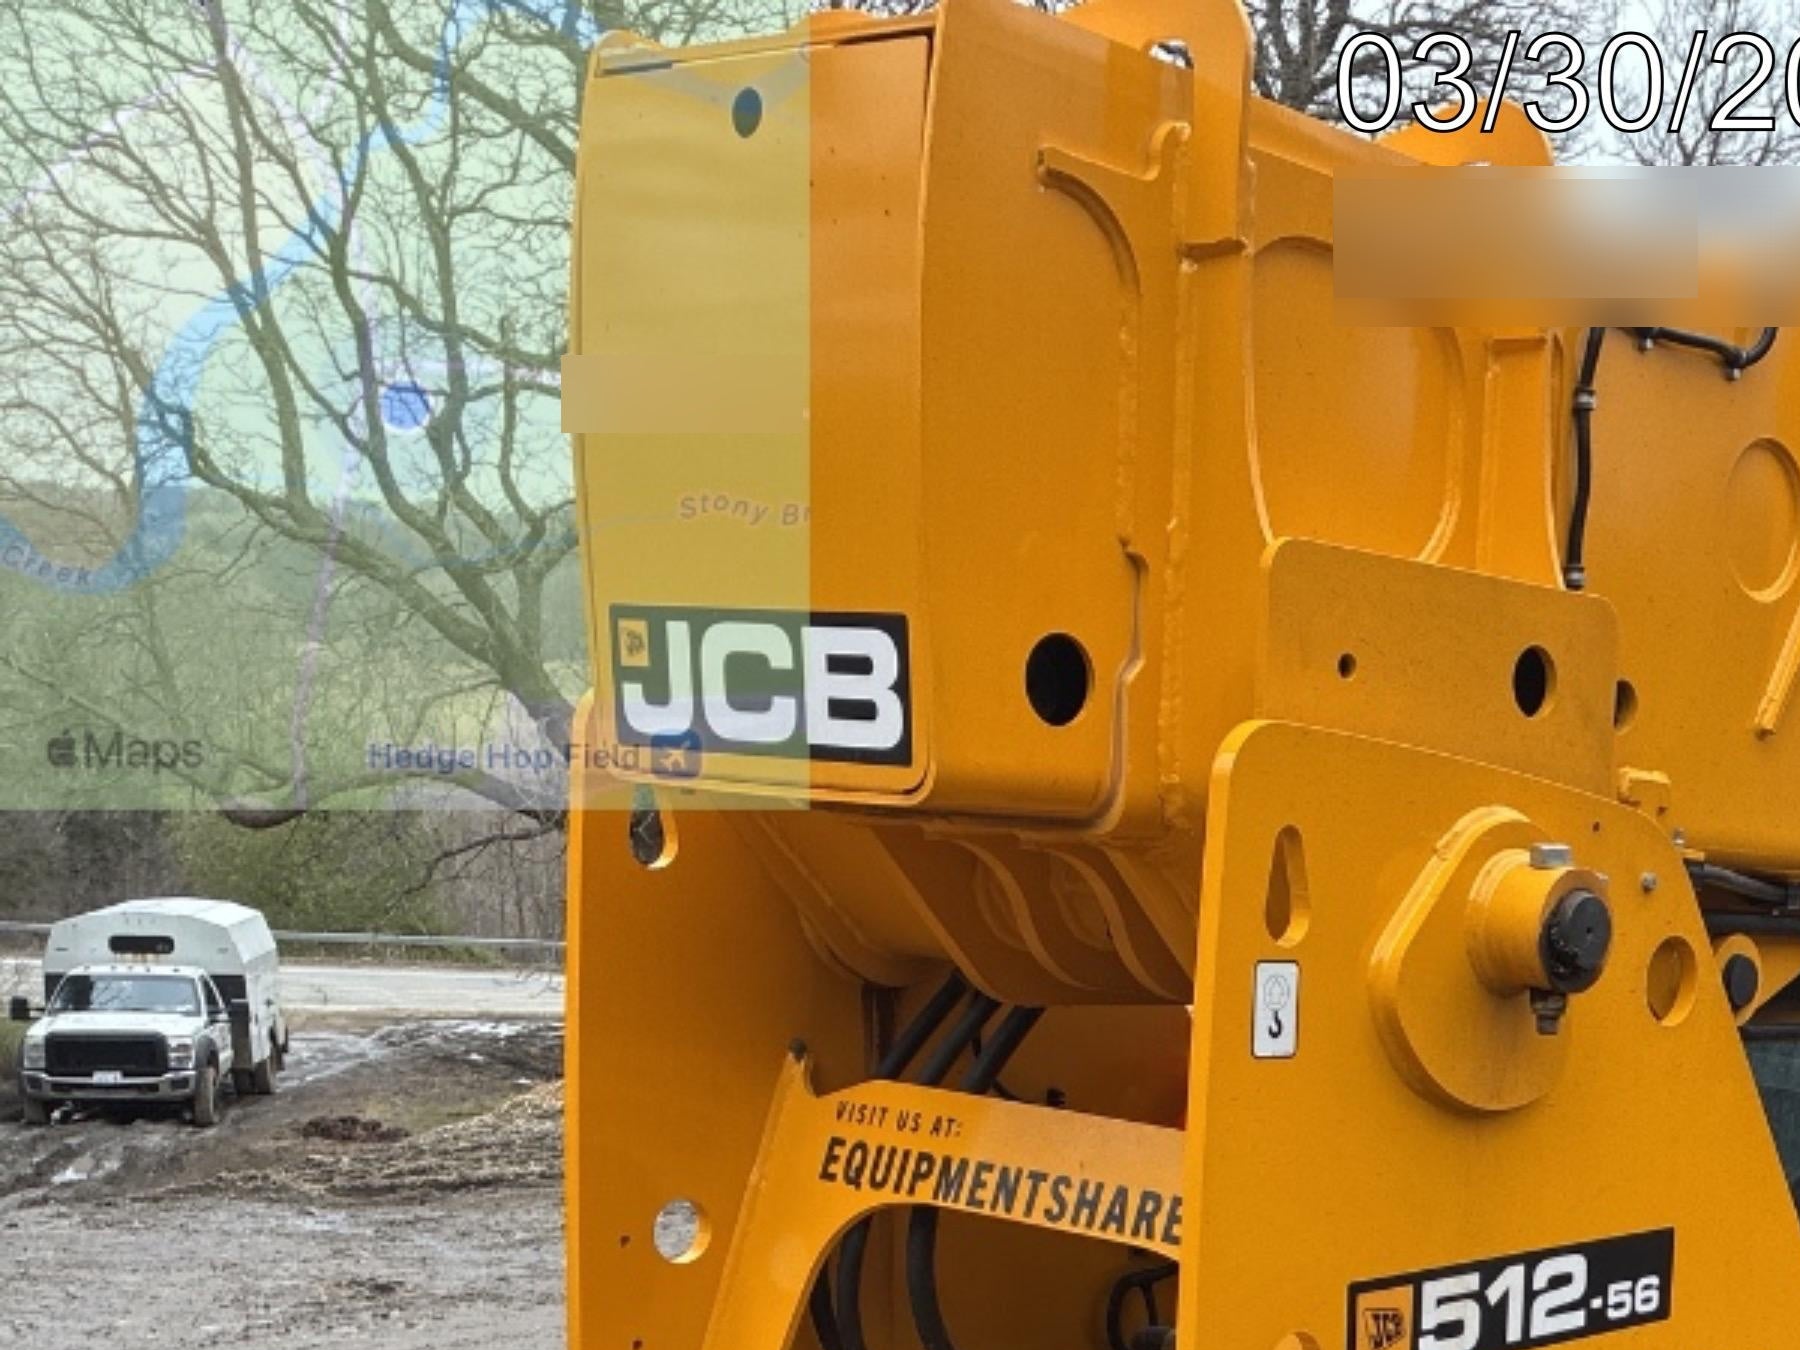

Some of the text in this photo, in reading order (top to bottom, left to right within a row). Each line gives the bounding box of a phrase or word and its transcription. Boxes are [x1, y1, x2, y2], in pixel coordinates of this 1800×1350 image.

[622, 618, 904, 751] JCB
[835, 1100, 963, 1138] VISIT US AT:
